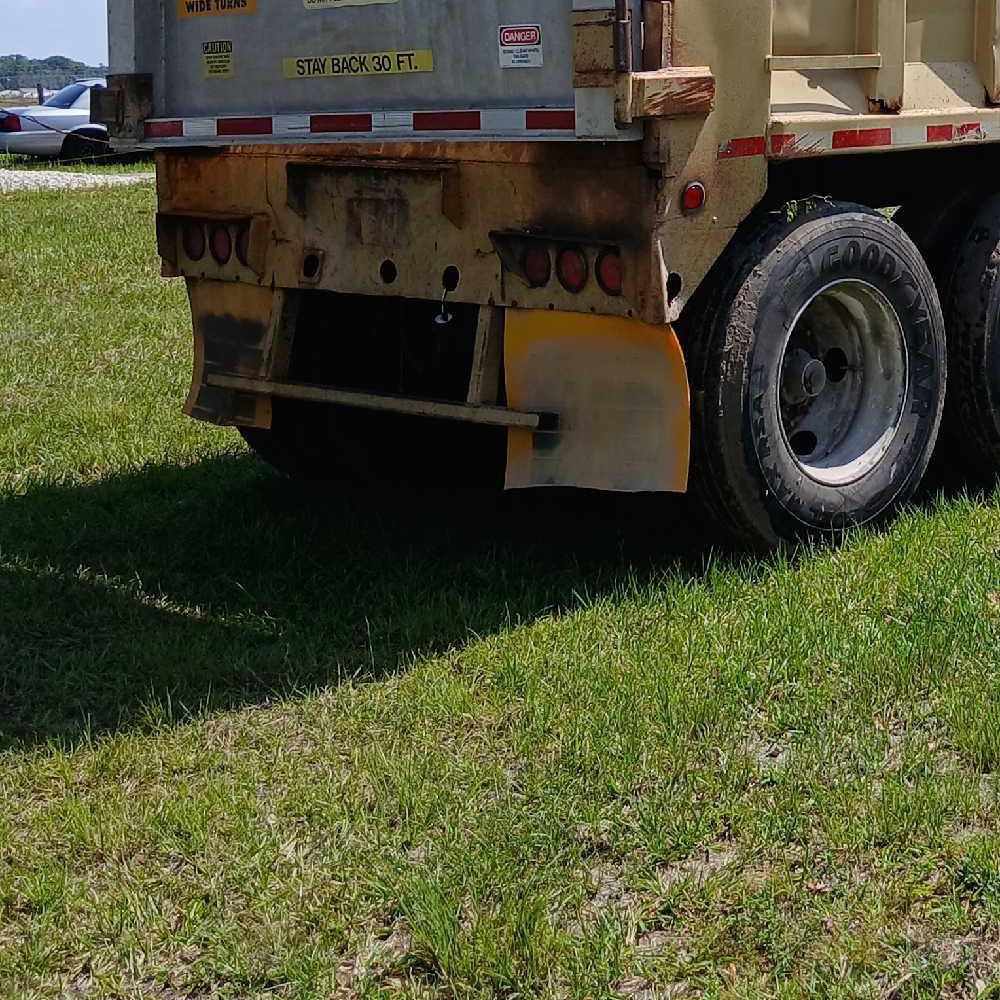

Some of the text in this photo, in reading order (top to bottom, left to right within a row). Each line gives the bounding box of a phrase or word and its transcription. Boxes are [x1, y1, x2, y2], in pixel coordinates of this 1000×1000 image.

[184, 0, 212, 13] WIDE
[504, 31, 537, 42] DANGER
[296, 53, 418, 75] STAY BACK 30 FT.
